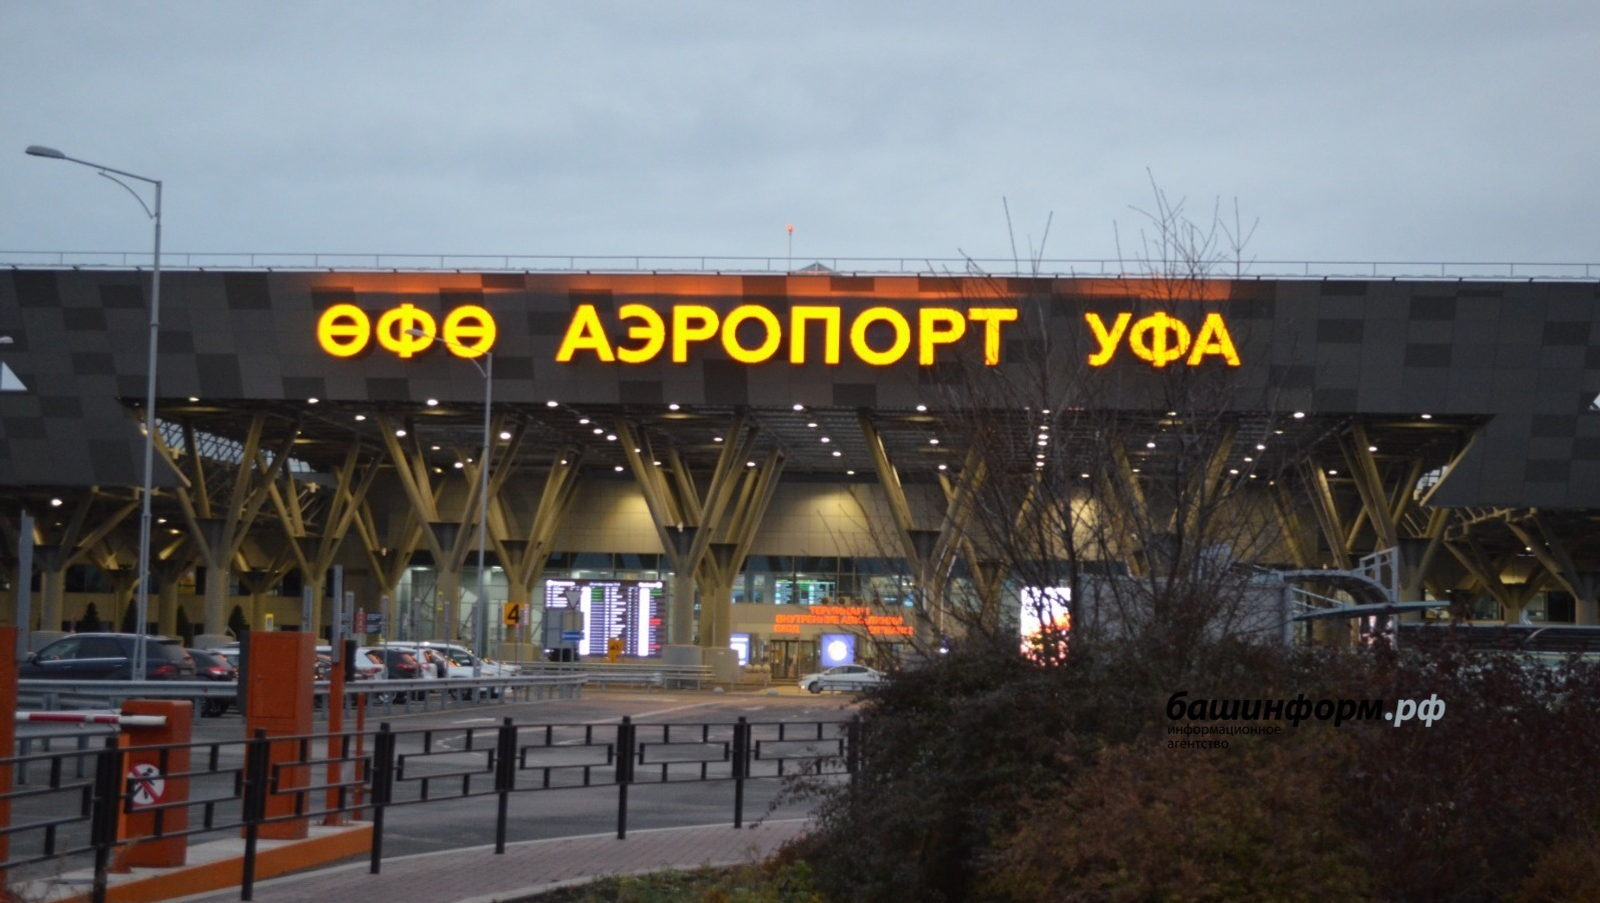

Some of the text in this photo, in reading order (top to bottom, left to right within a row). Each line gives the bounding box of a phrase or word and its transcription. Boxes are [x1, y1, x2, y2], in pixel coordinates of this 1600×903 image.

[316, 303, 1241, 367] ӨФӨ АЭРОПОРТ УФА
[507, 603, 520, 624] 4
